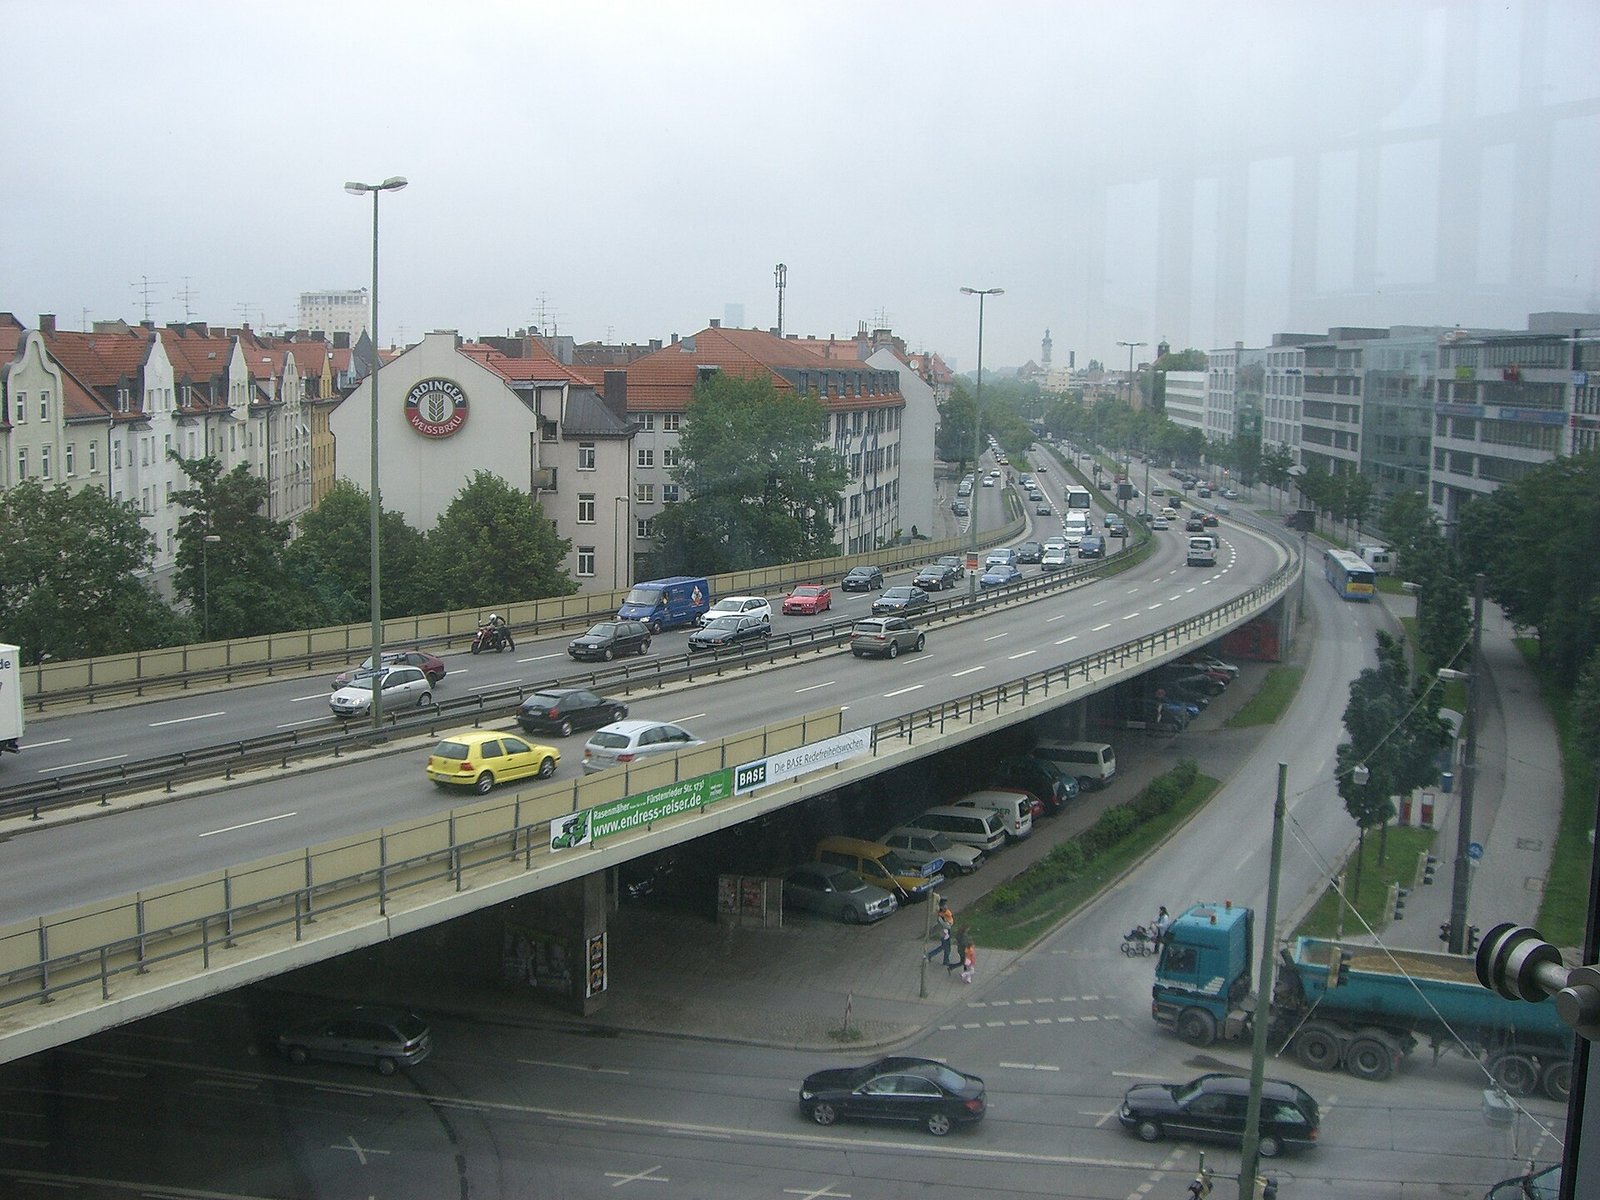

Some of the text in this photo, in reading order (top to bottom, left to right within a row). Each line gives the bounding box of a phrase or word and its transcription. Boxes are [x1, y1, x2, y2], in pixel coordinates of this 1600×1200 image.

[408, 381, 464, 404] ERDINGER
[774, 762, 786, 774] Die
[786, 755, 803, 770] BASE
[739, 766, 765, 786] BASE
[593, 792, 702, 838] www.endress-reiser.de
